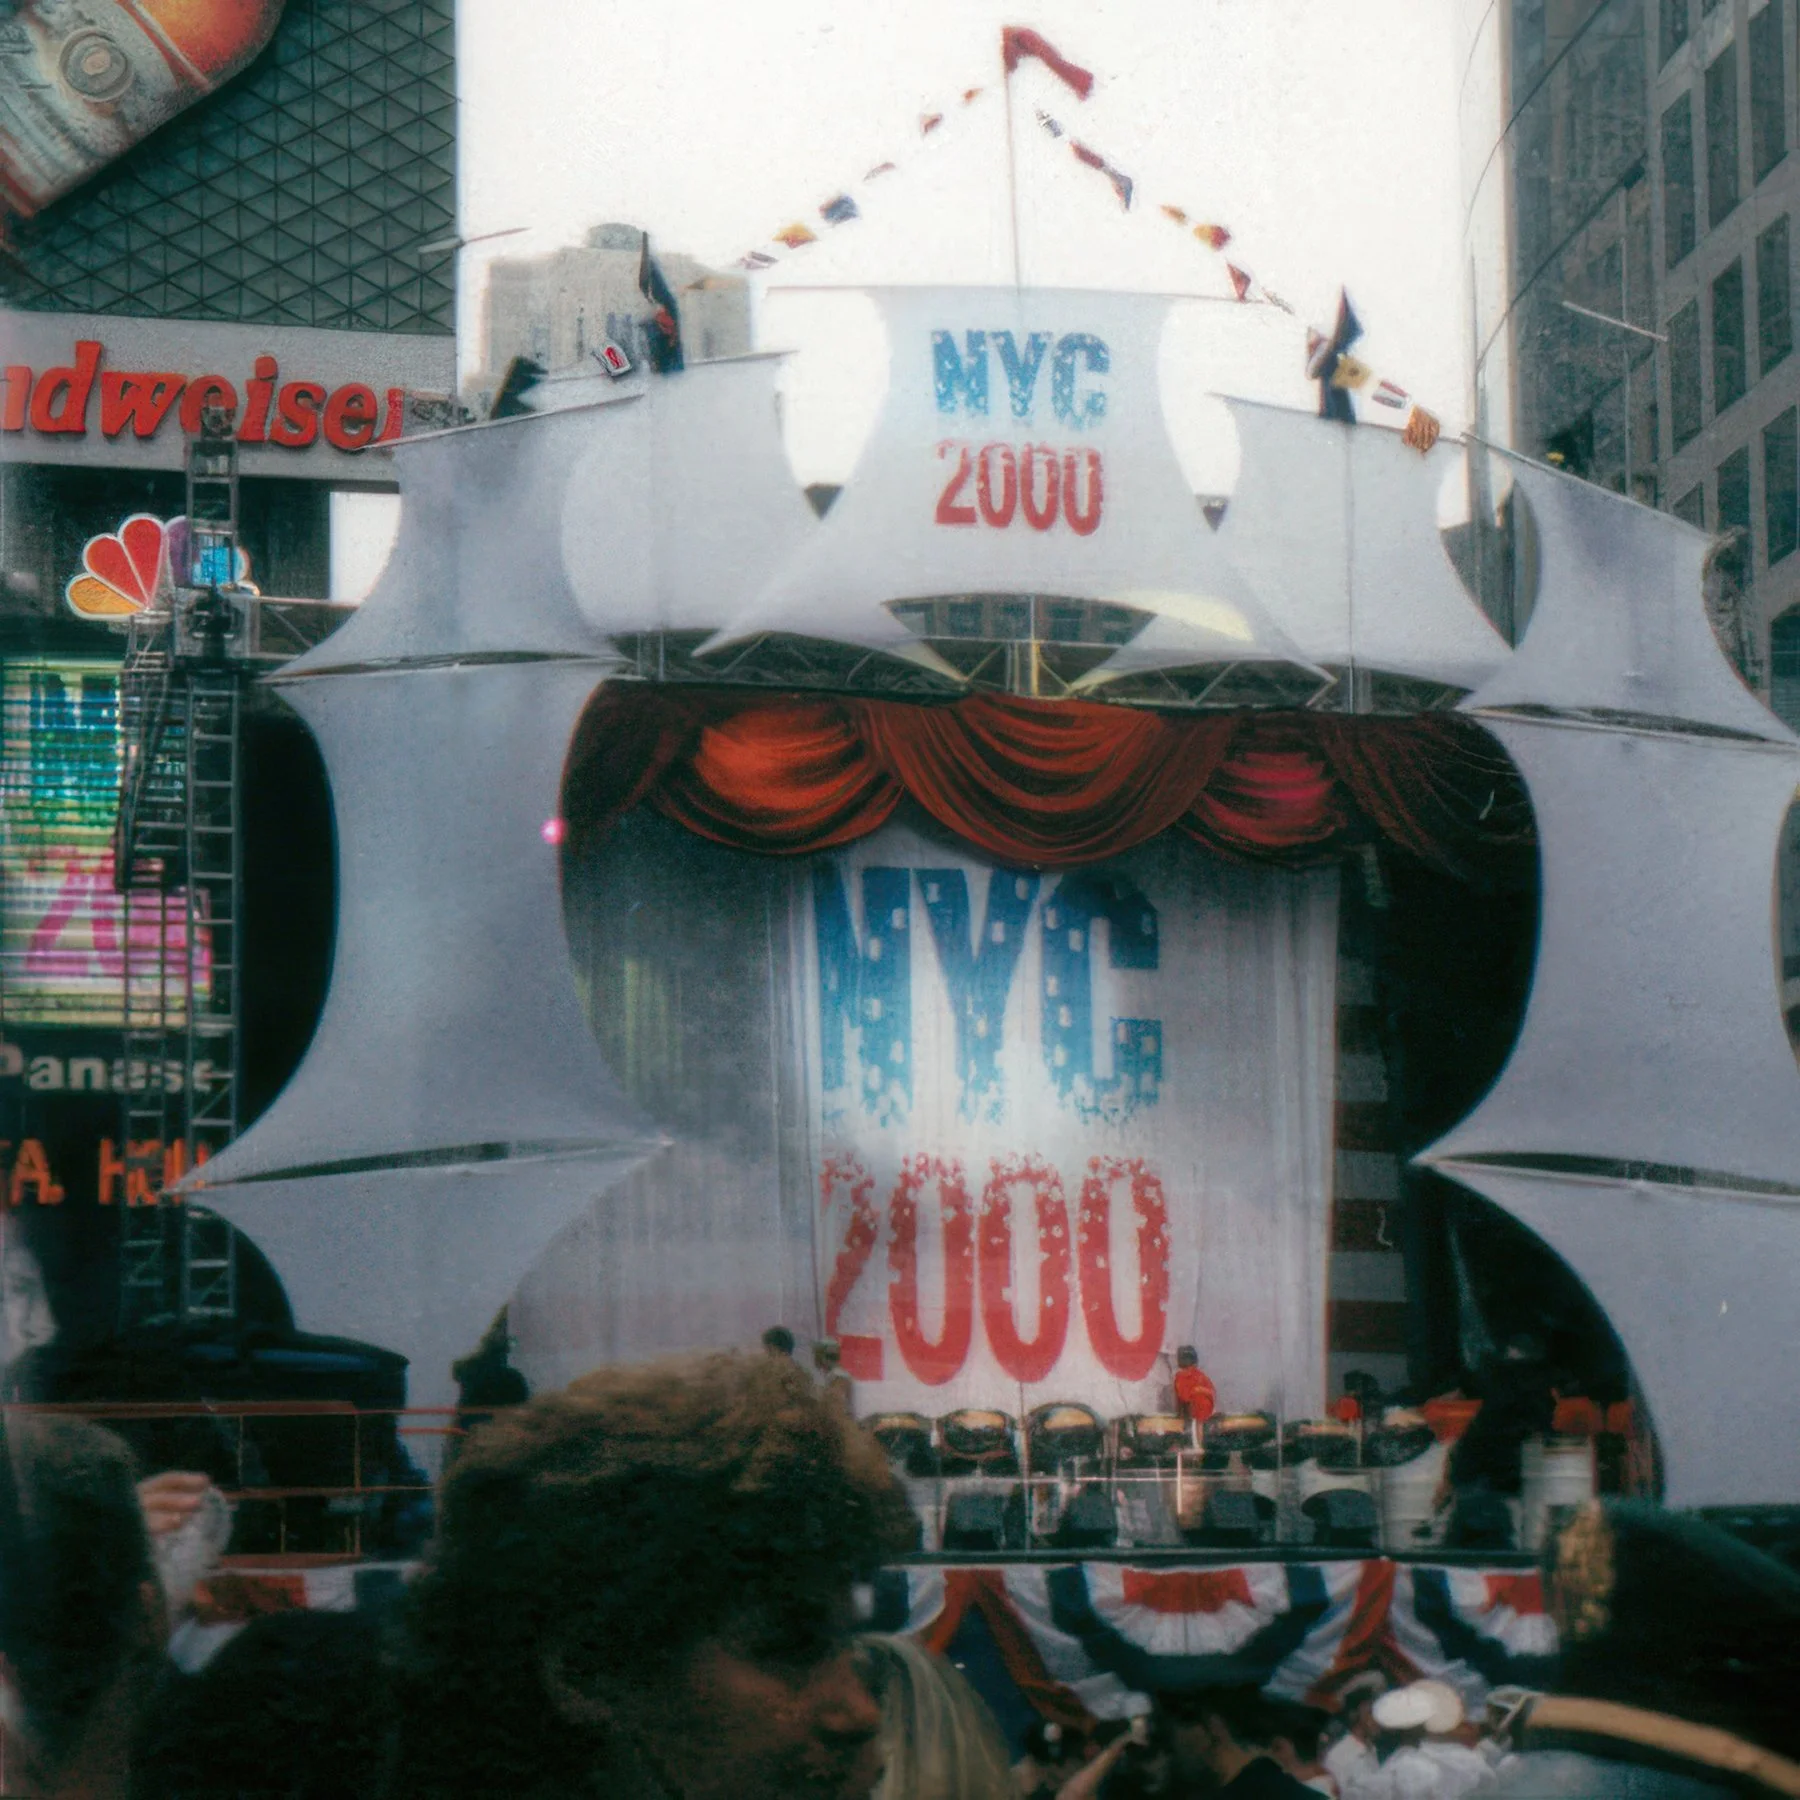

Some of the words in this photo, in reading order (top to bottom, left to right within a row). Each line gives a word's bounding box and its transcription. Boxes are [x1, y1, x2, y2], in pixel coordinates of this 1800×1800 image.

[932, 329, 1109, 431] NYC
[936, 438, 1104, 536] 2000
[814, 867, 1164, 1127] NYC
[0, 1137, 65, 1206] A.
[819, 1152, 1170, 1386] 2000
